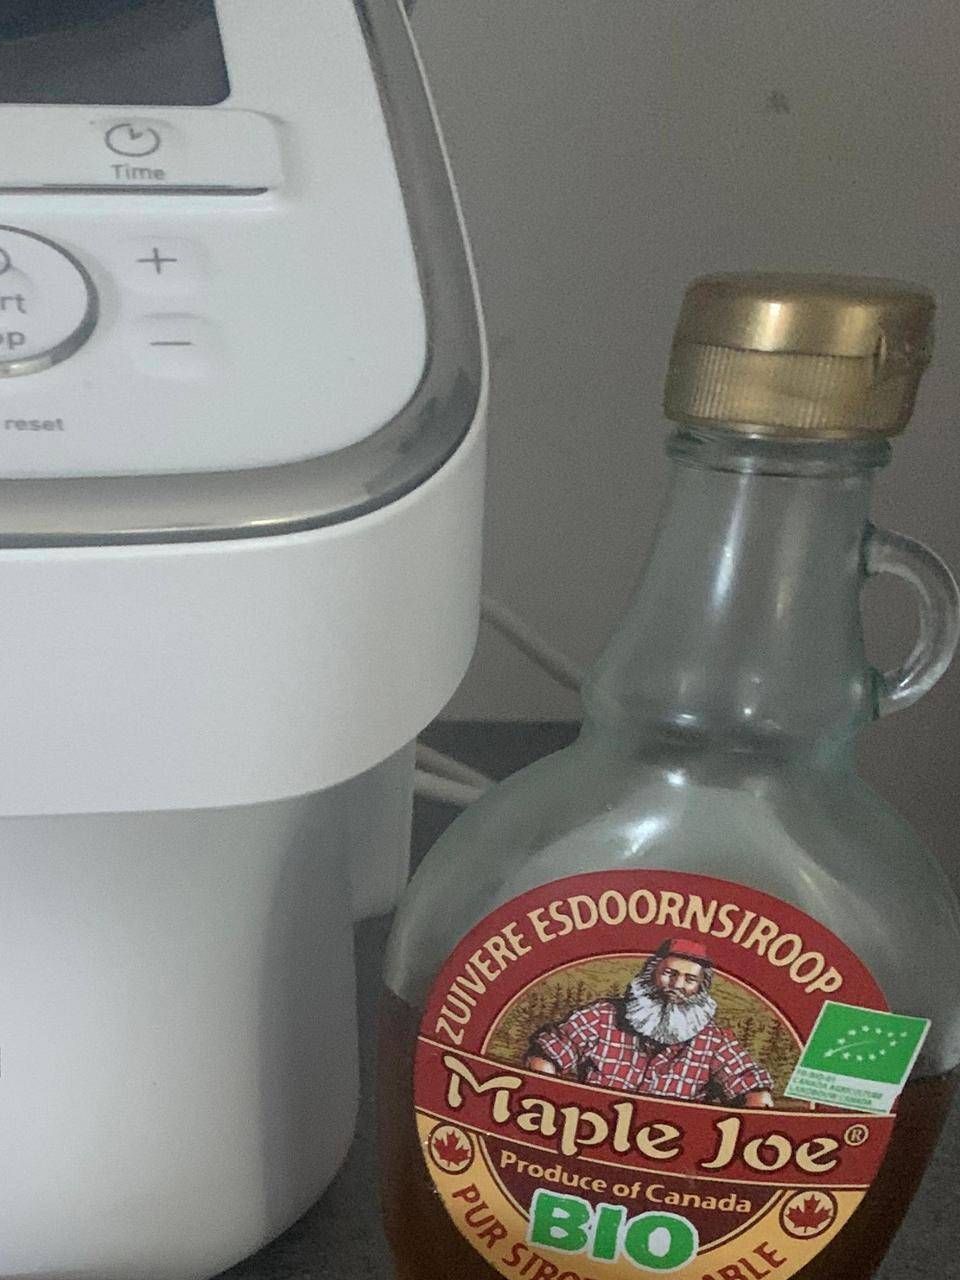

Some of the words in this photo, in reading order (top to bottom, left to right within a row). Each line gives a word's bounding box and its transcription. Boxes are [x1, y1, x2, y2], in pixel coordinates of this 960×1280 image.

[112, 164, 166, 181] Time
[5, 416, 65, 432] reset
[436, 921, 534, 1046] ZUIVERE
[527, 888, 844, 996] ESDOORNSIROOP
[442, 1055, 682, 1158] Maple
[498, 1149, 608, 1195] Produce
[612, 1178, 644, 1203] of
[647, 1182, 753, 1215] Canada
[452, 1183, 510, 1250] PUR
[526, 1186, 701, 1274] BIO
